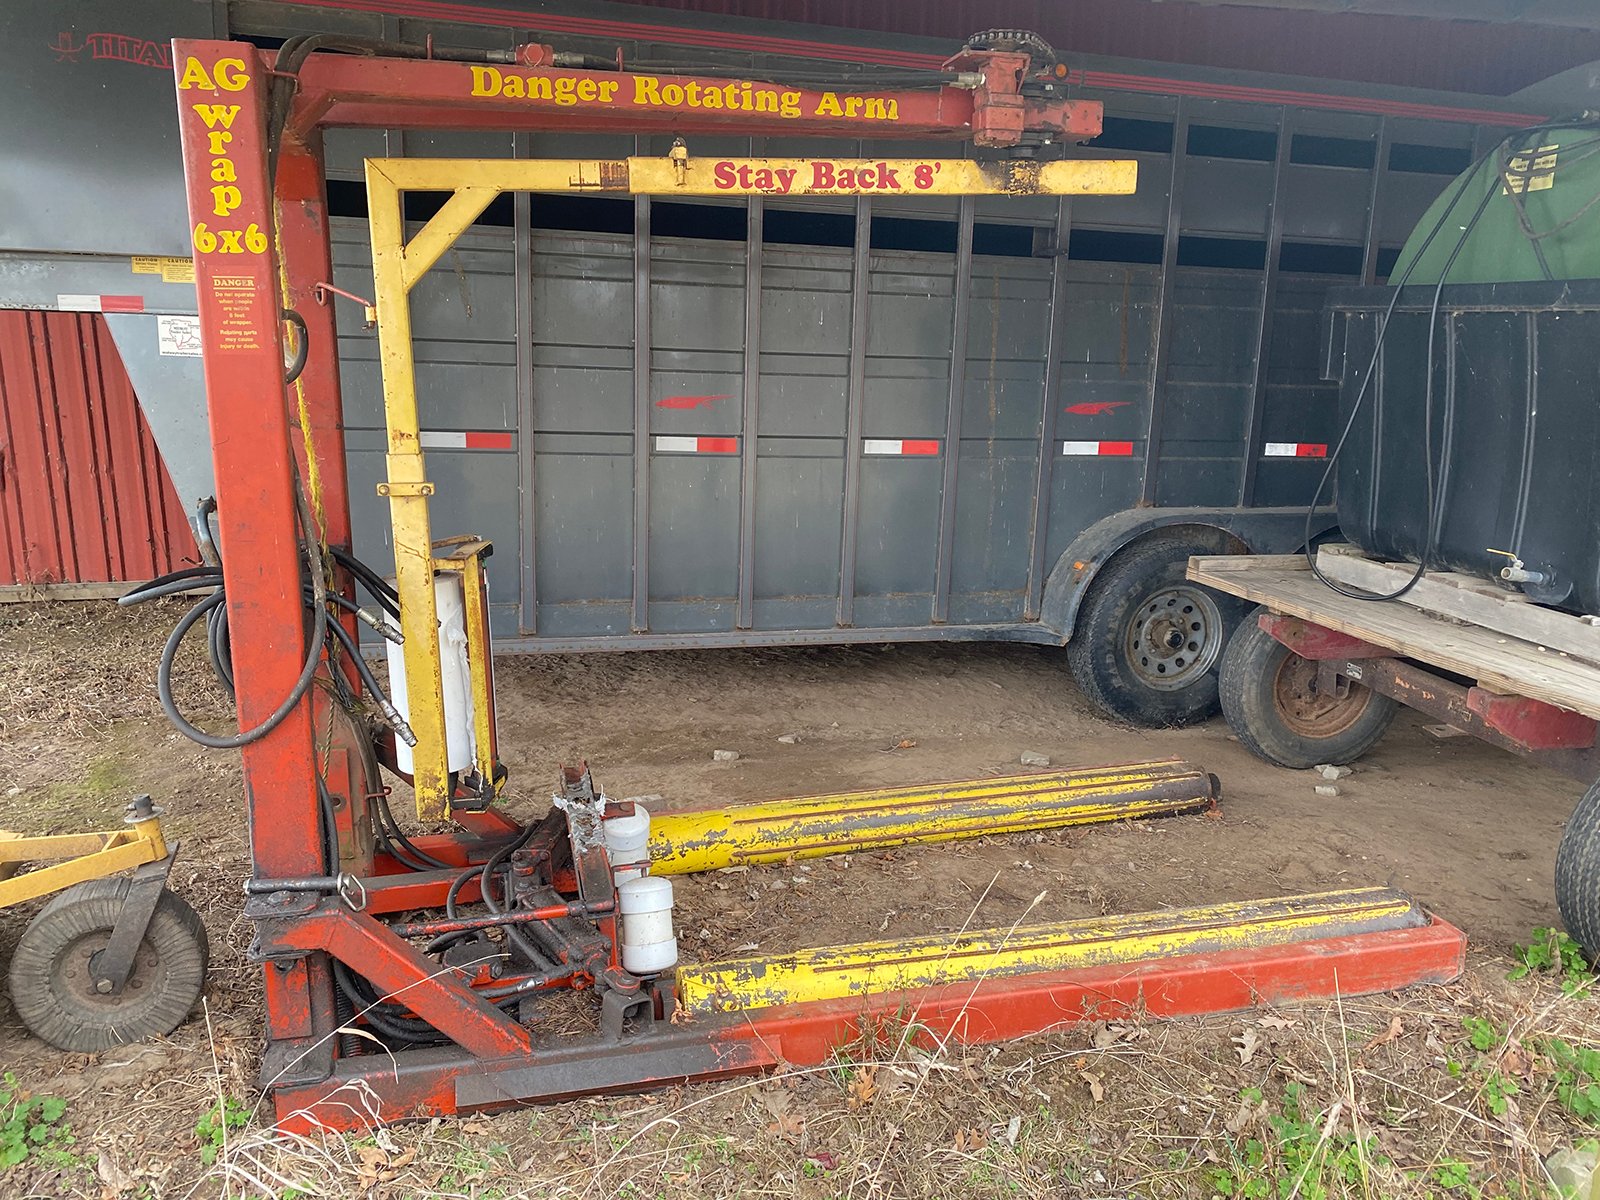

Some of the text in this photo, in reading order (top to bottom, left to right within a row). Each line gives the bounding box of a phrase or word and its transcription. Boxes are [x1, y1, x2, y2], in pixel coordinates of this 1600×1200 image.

[178, 56, 250, 91] AG
[471, 65, 900, 121] Danger Rotating Arm
[714, 161, 941, 195] Stay Back 8'
[193, 222, 268, 254] 6x6
[213, 279, 255, 287] DANGER
